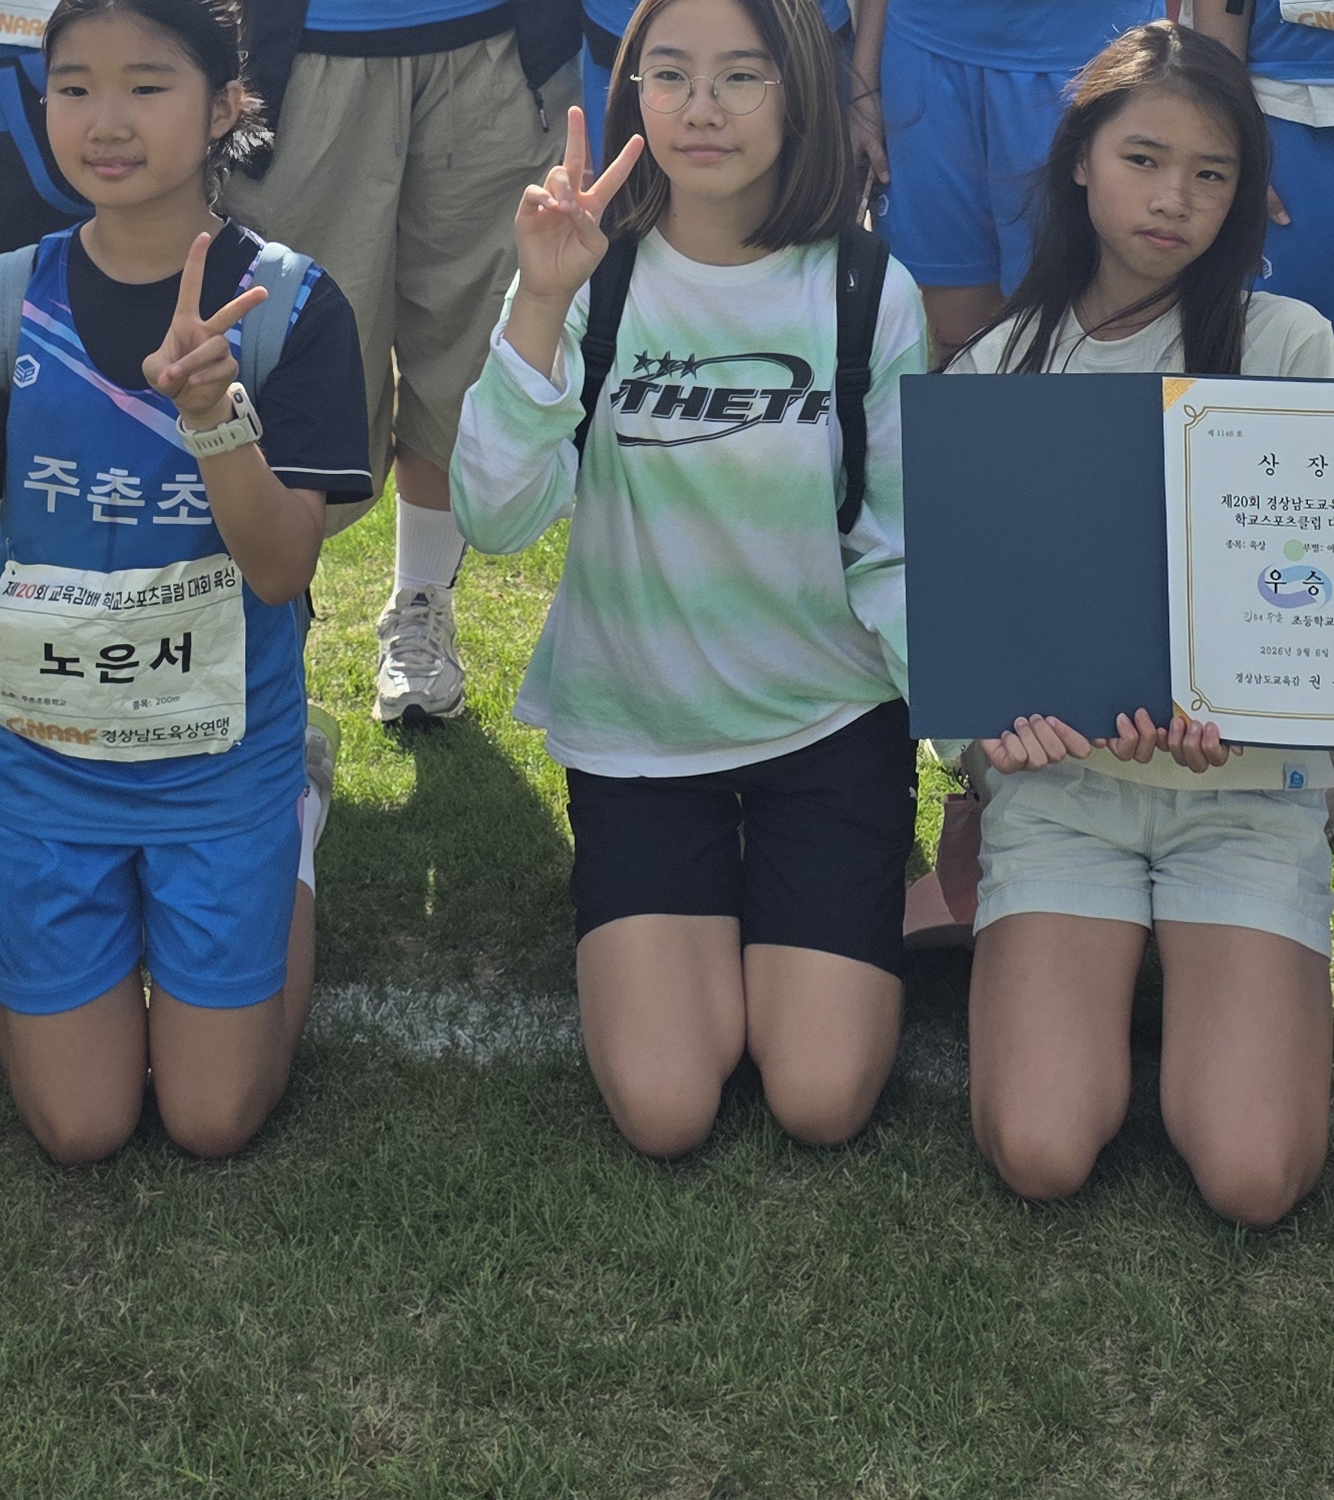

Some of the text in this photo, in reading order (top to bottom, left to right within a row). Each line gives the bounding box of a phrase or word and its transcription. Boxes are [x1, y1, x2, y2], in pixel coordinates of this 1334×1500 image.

[23, 455, 213, 525] 주촌초
[1221, 494, 1260, 509] 제20회
[1235, 512, 1321, 530] 학교스포츠클럽
[1249, 540, 1266, 551] 육상
[2, 566, 236, 611] 제20회 교육감배 학교스포츠클럽 대회 육상
[1291, 615, 1334, 627] 초등학교
[39, 631, 192, 684] 노은서
[1235, 672, 1300, 687] 경상남도교육감
[6, 717, 98, 745] GNAAF
[102, 717, 229, 743] 경상남도육상연맹
